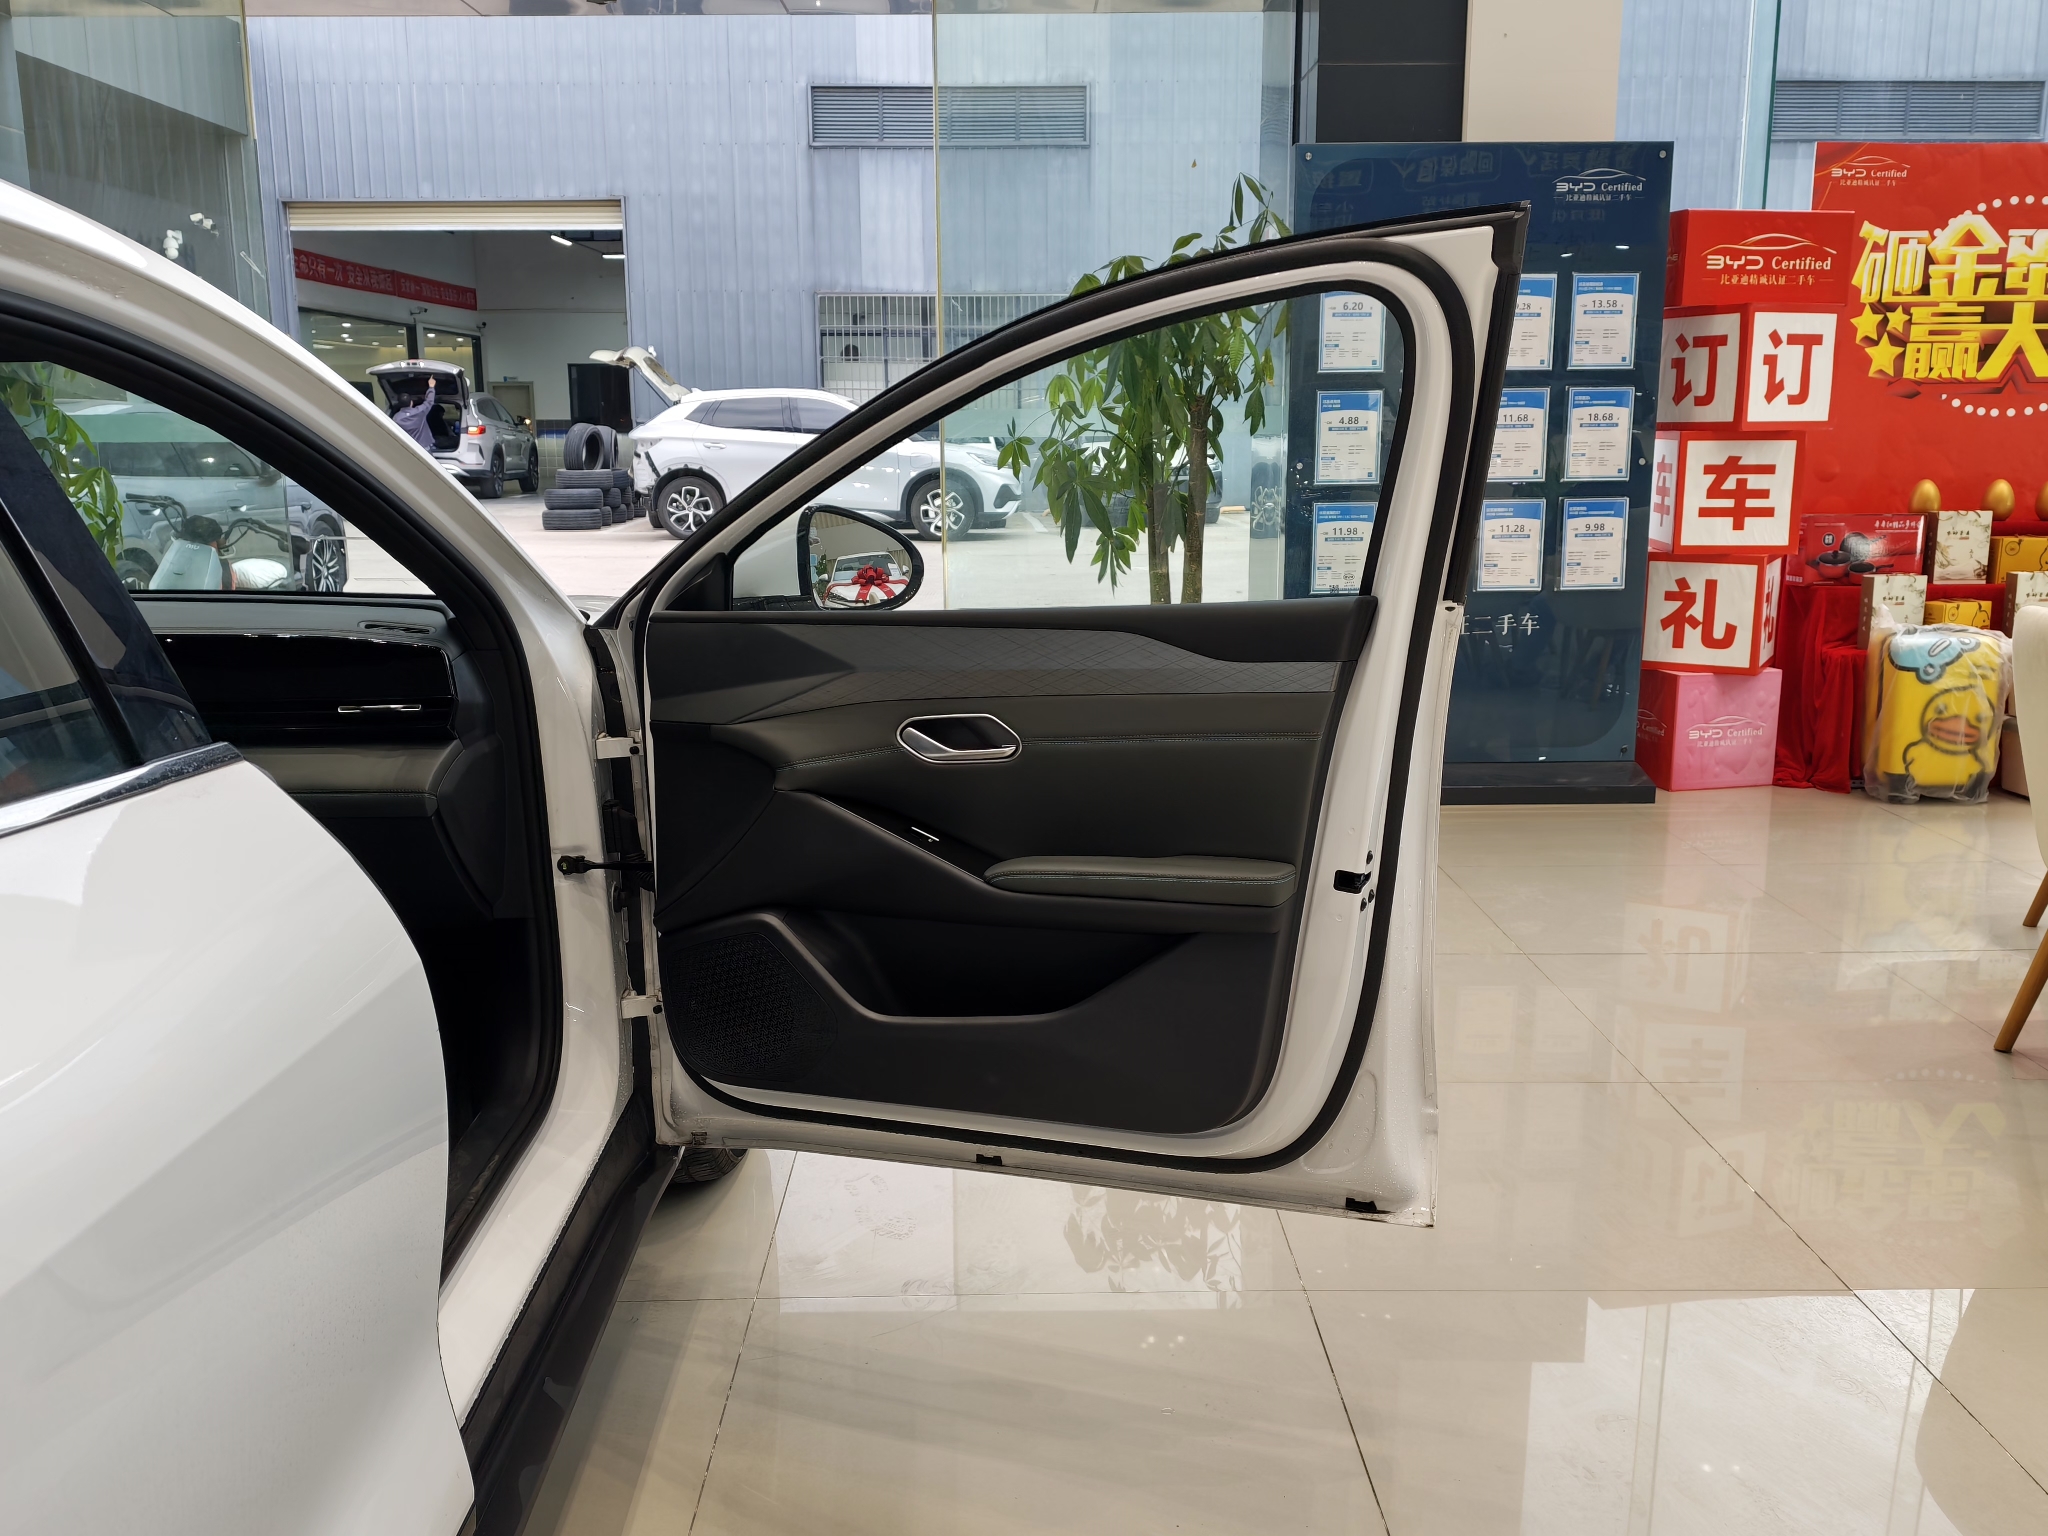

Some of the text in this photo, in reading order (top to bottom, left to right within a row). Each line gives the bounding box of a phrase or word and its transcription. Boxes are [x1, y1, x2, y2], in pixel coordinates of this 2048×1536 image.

[1831, 167, 1907, 178] BYD Certified
[1556, 182, 1643, 192] BYD Certified
[1706, 255, 1831, 270] BYD Certified
[1720, 273, 1815, 286] 比亚迪精诚认证二手车
[1343, 301, 1364, 311] 6.20
[1591, 299, 1618, 309] 13.58
[1671, 333, 1728, 406] 订
[1763, 328, 1824, 405] 订
[1338, 416, 1359, 425] 4.88
[1503, 413, 1529, 422] 11.68
[1587, 412, 1614, 422] 18.68
[1654, 454, 1673, 528] 车
[1698, 455, 1776, 530] 车
[1332, 527, 1358, 536] 11.98
[1499, 524, 1526, 533] 11.28
[1585, 522, 1606, 532] 9.98
[1660, 576, 1738, 650] 礼
[1763, 575, 1775, 650] 礼
[1688, 727, 1763, 740] BYD Certified
